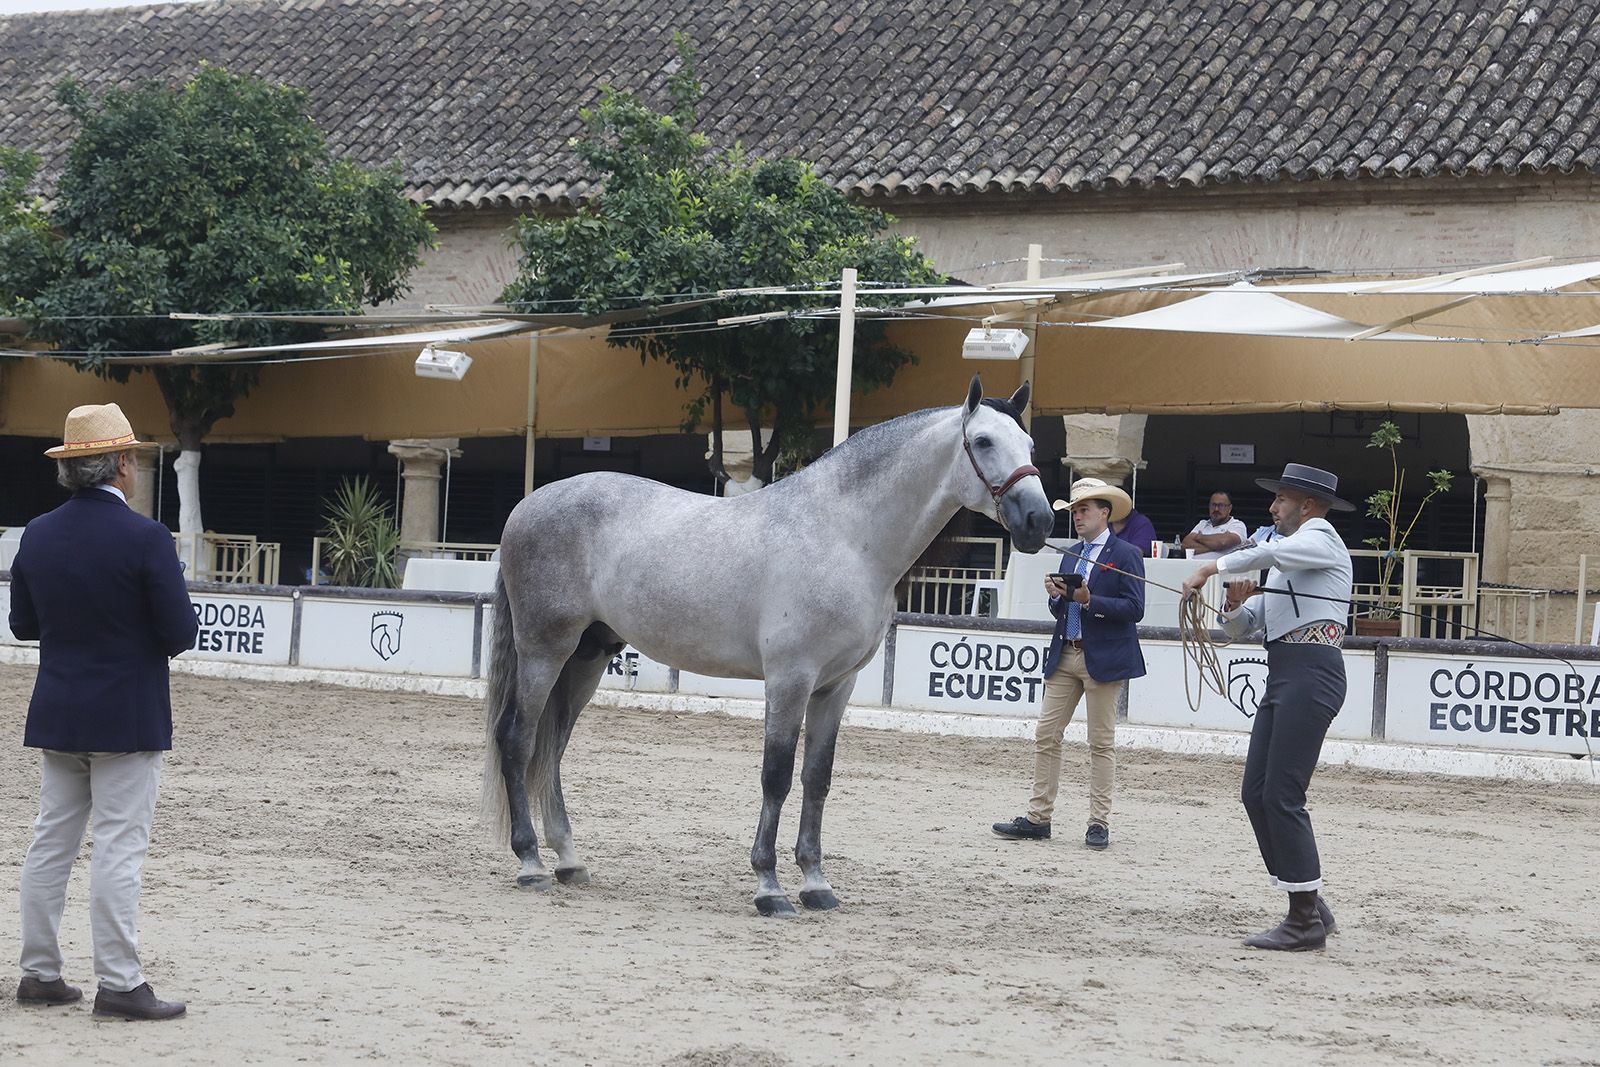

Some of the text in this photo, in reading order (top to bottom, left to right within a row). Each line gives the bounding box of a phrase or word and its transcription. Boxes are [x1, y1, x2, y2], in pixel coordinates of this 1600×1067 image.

[192, 603, 265, 628] RDOBA
[197, 629, 264, 654] ESTRE
[930, 636, 1050, 673] CÓRDO
[928, 672, 1045, 703] ECUEST
